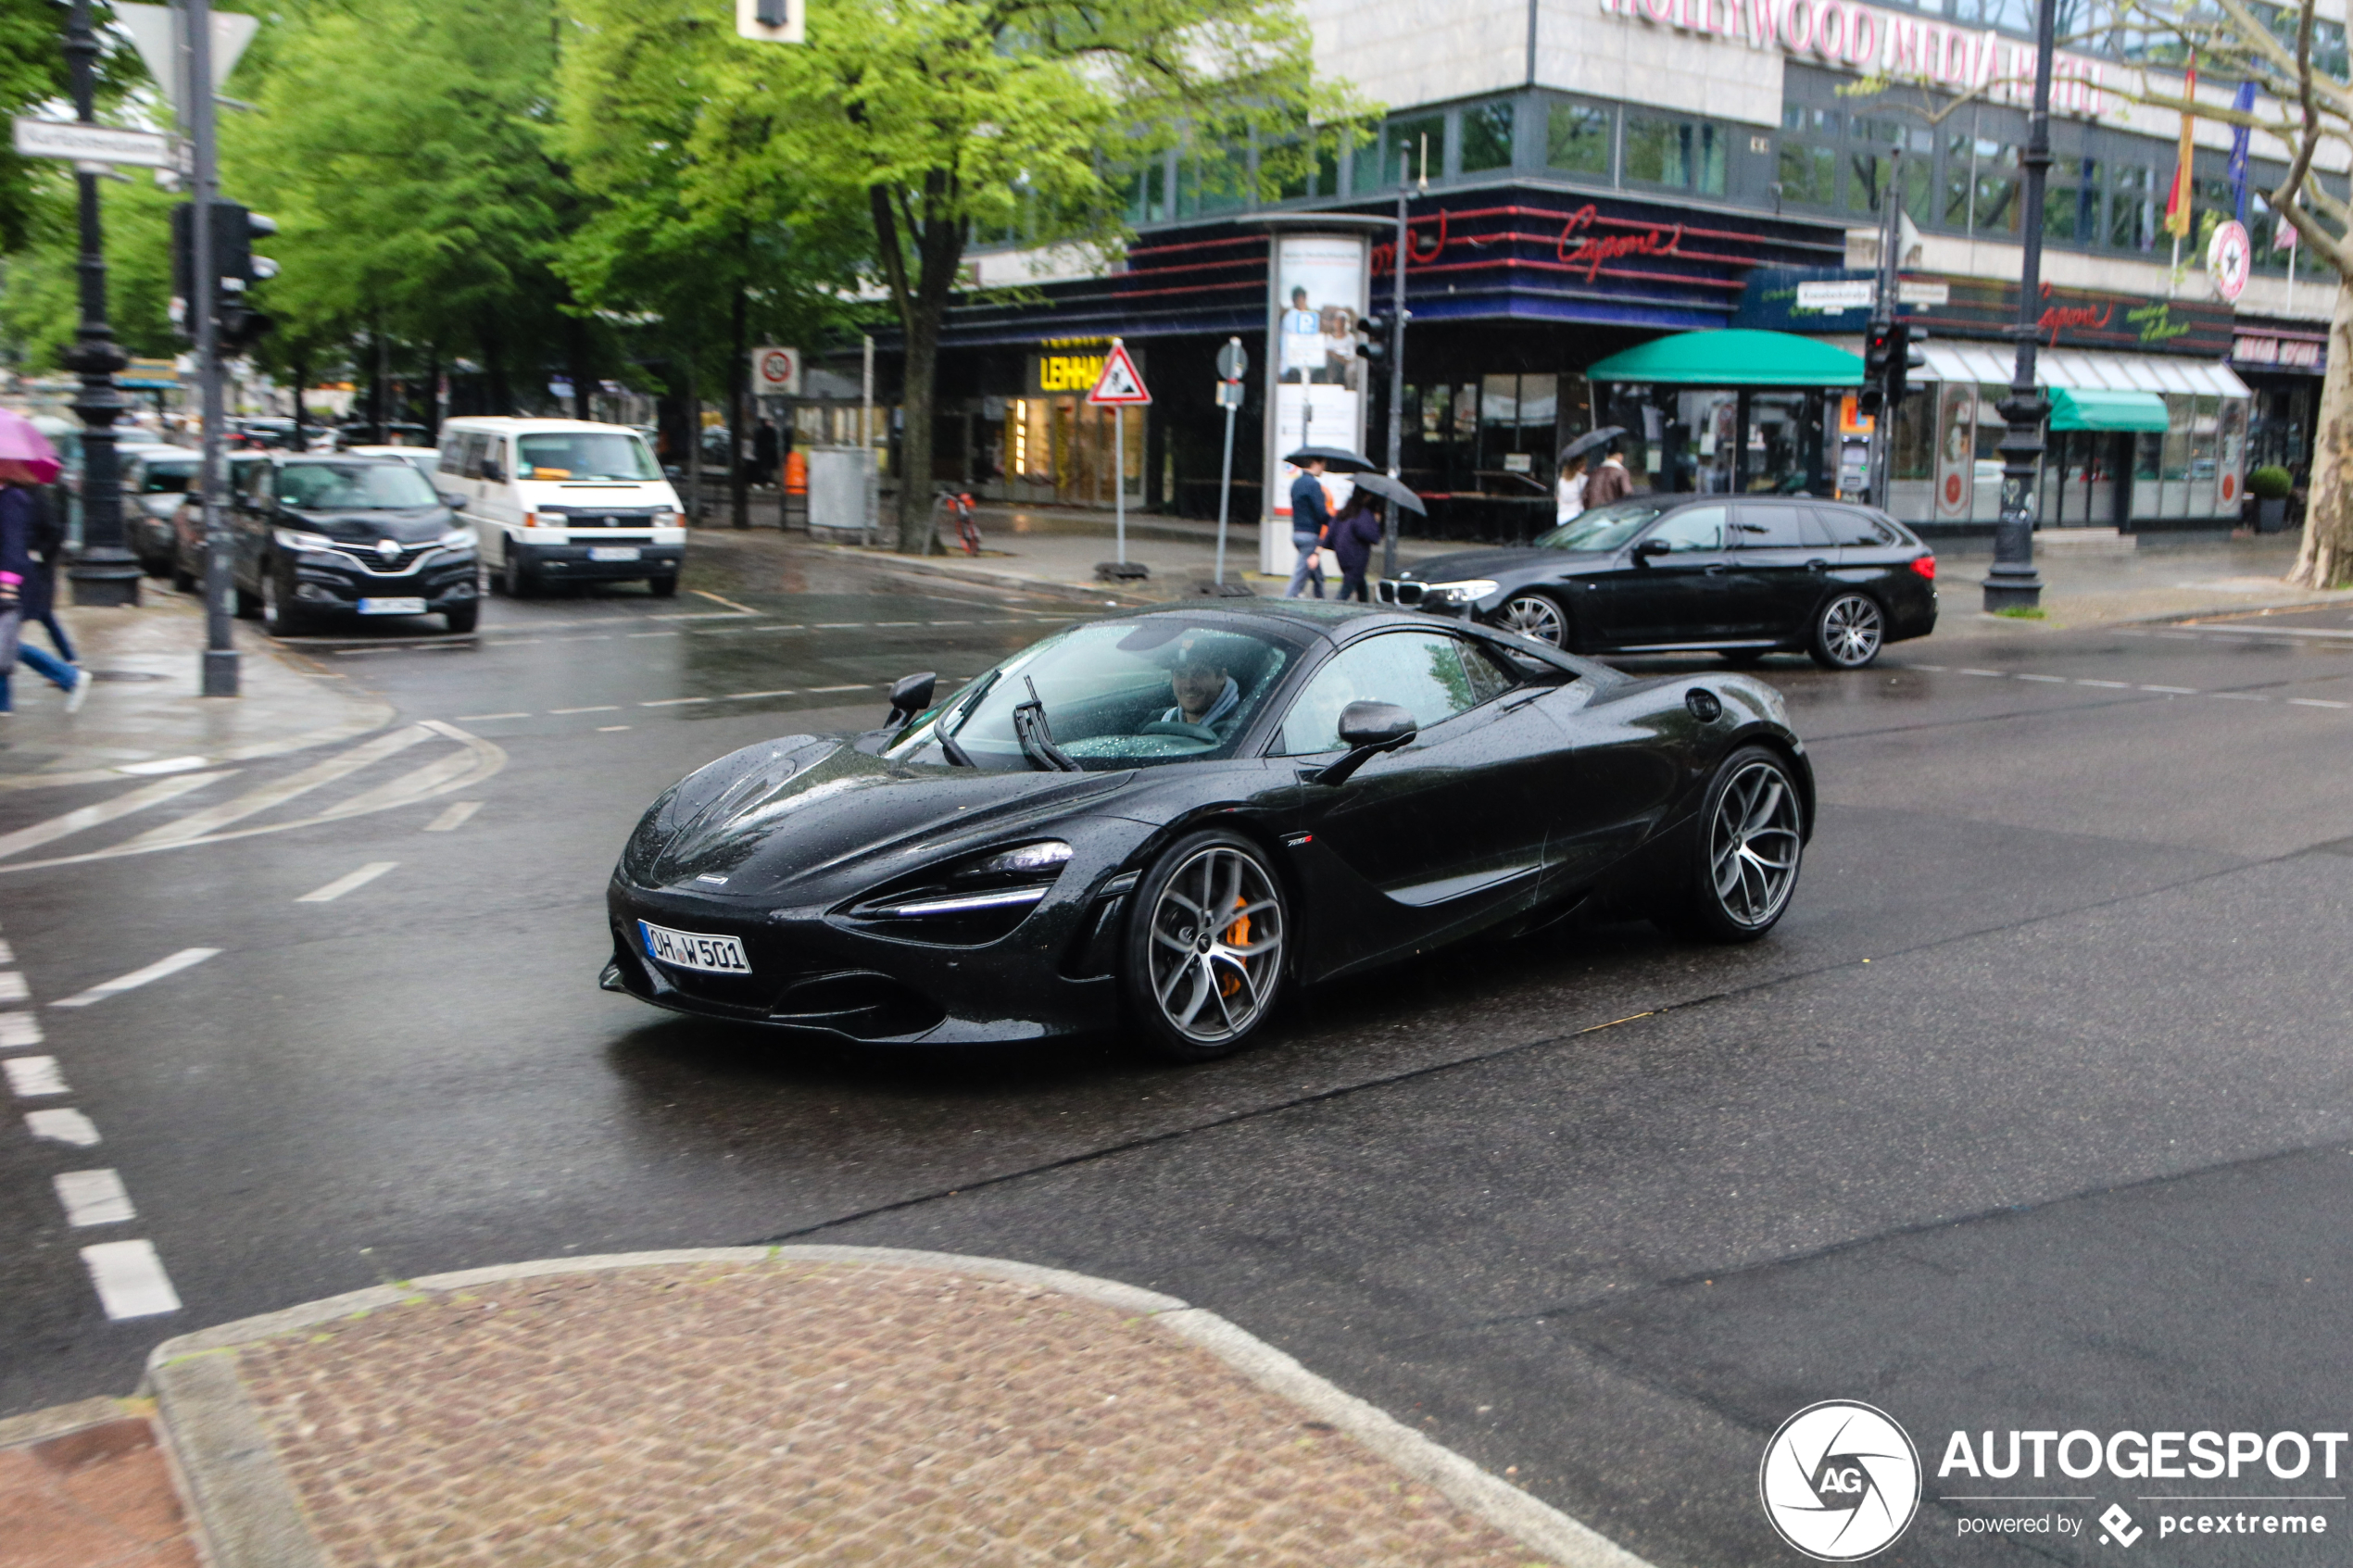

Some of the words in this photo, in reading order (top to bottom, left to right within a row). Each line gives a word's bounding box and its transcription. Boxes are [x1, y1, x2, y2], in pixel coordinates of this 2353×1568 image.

[1881, 16, 1999, 91] MEDIA
[1557, 204, 1683, 283] Capone
[650, 929, 676, 960] OH
[698, 940, 746, 969] 501
